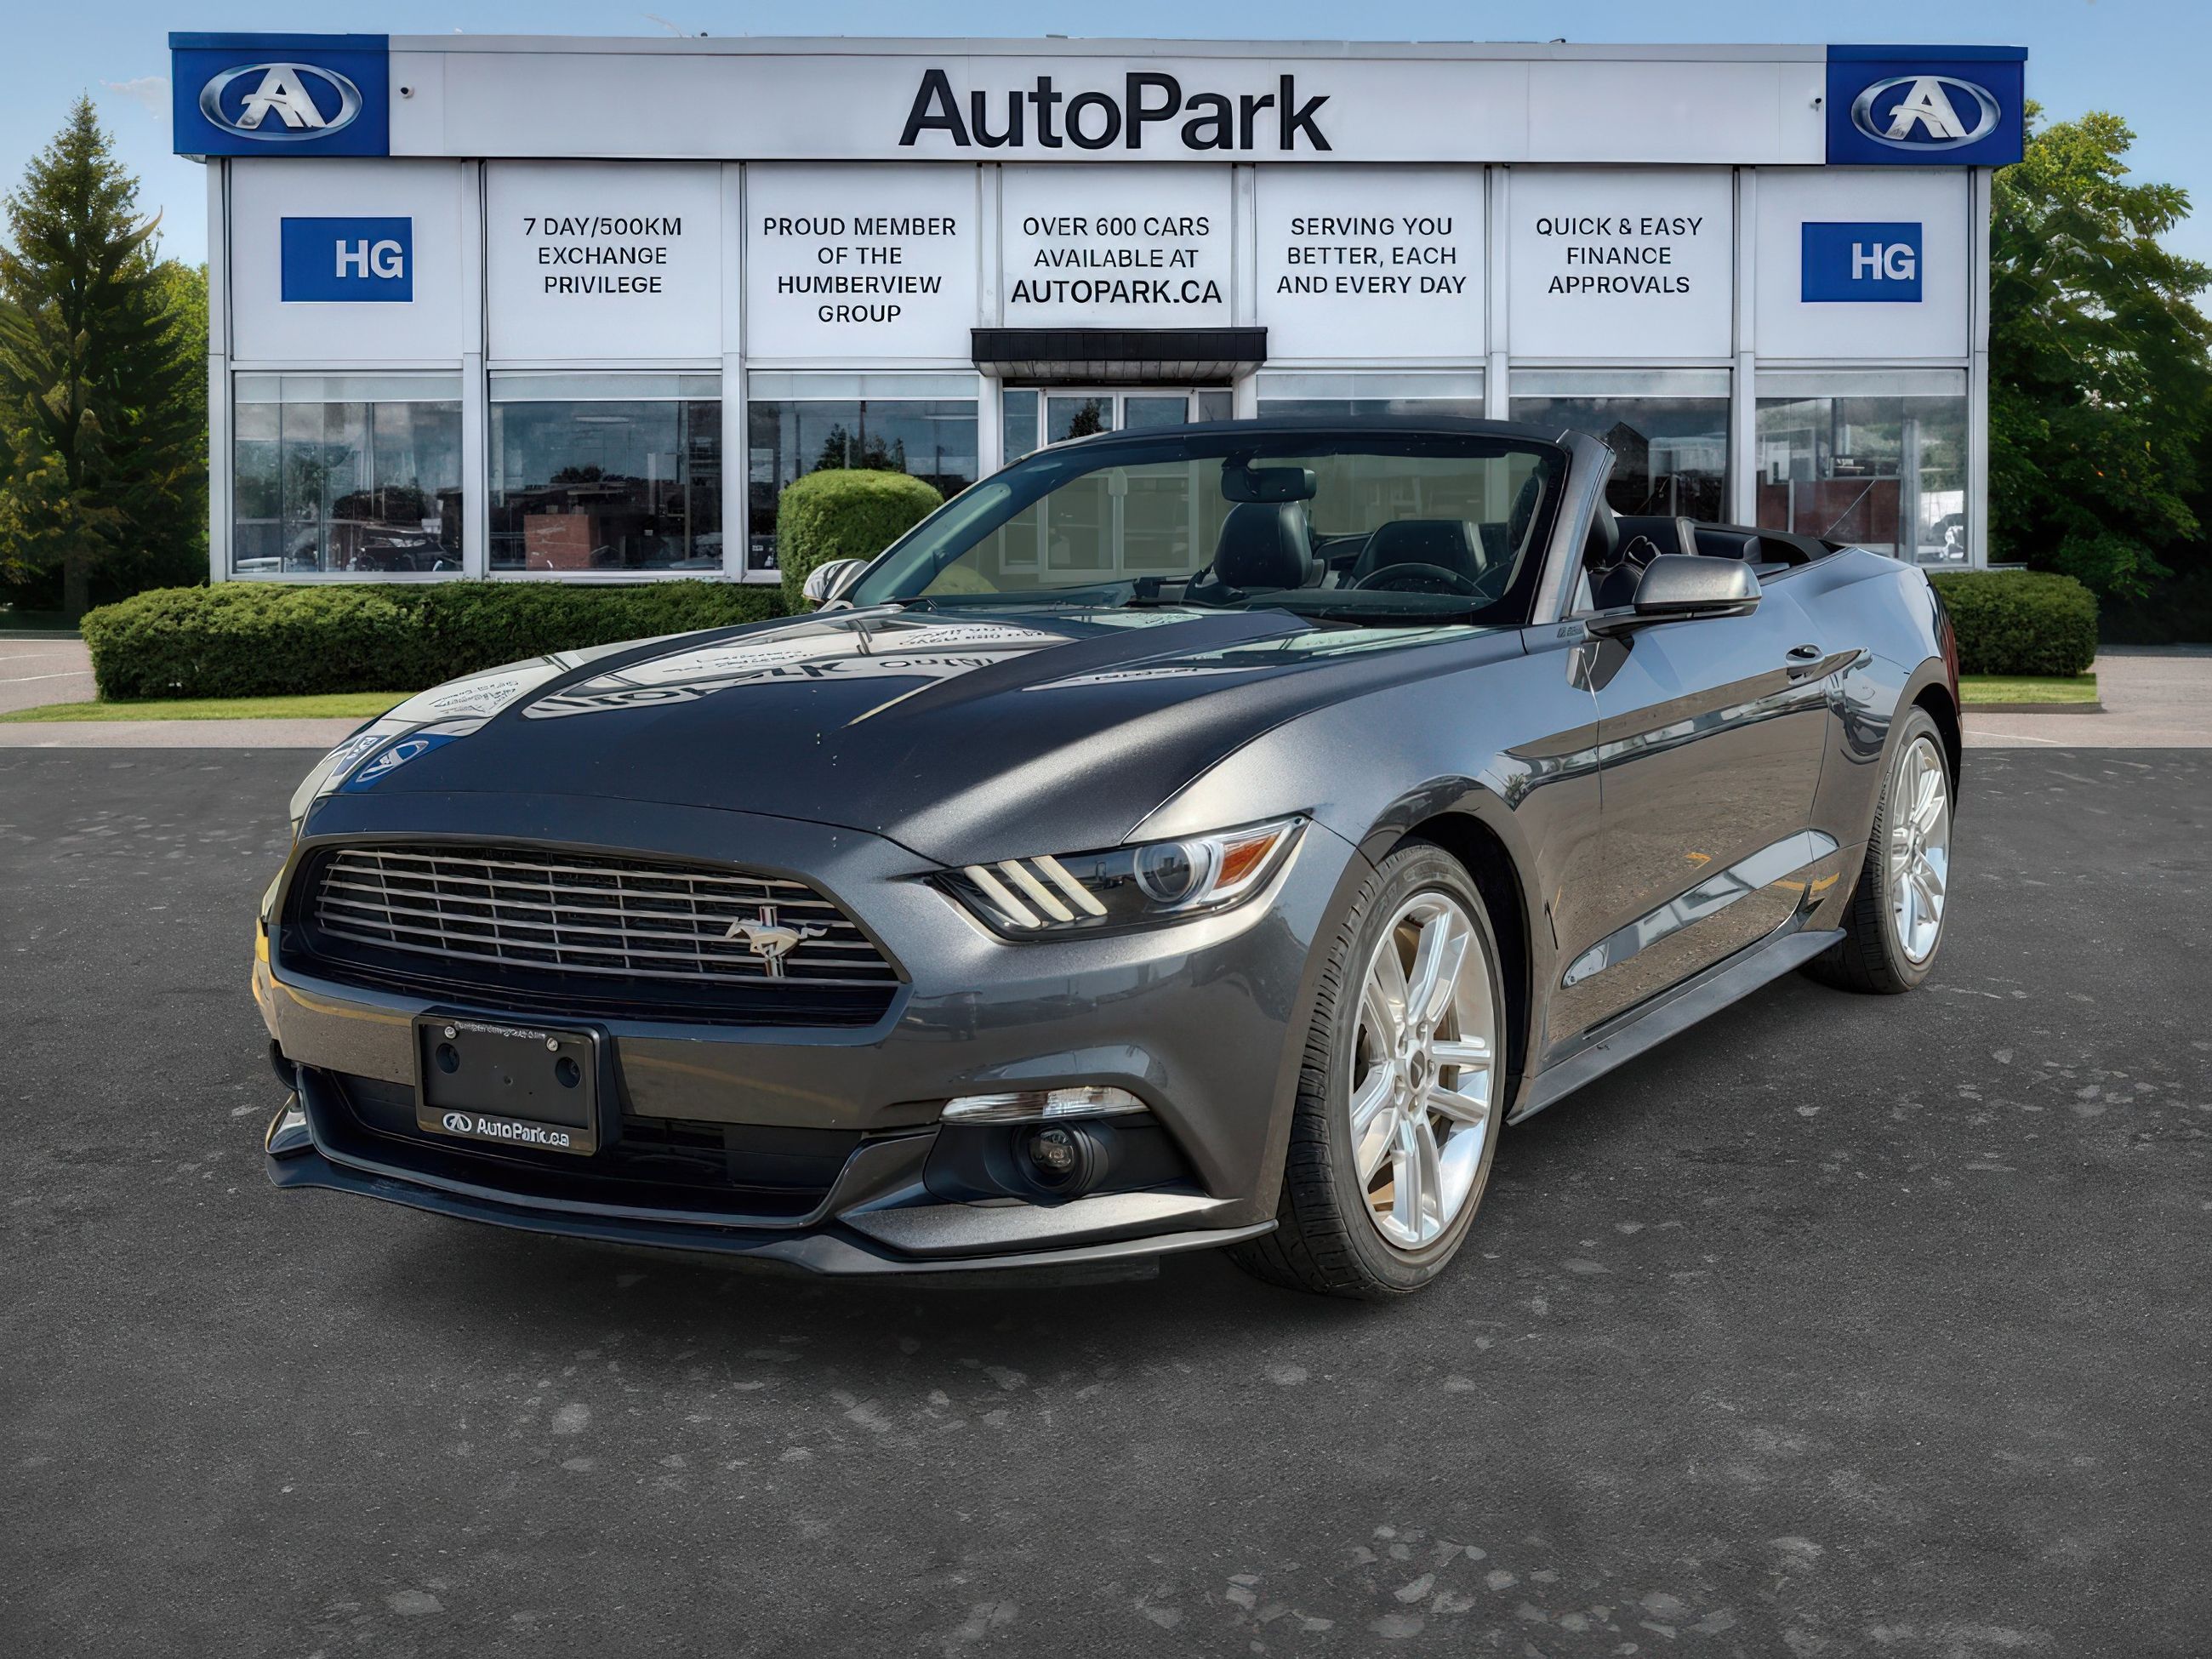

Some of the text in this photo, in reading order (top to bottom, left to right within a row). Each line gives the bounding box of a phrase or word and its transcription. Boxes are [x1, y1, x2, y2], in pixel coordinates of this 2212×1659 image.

[898, 69, 1333, 151] AutoPark
[523, 217, 681, 238] 7 DAY/500KM
[764, 217, 956, 236] PROUD MEMBER
[1023, 216, 1210, 237] OVER 600 CARS
[1291, 217, 1452, 236] SERVING YOU
[1536, 217, 1703, 237] QUICK & EASY
[336, 240, 403, 278] HG
[539, 246, 667, 265] EXCHANGE
[818, 247, 902, 265] OF THE
[1034, 248, 1200, 268] AVAILABLE AT
[1287, 247, 1457, 268] BETTER, EACH
[1567, 247, 1672, 265] FINANCE
[1852, 242, 1915, 281] HG
[544, 276, 662, 294] PRIVILEGE
[778, 276, 942, 294] HUMBERVIEW
[1011, 279, 1223, 304] AUTOPARK.CA
[1276, 276, 1467, 294] AND EVERY DAY
[1548, 275, 1690, 294] APPROVALS
[818, 304, 901, 323] GROUP
